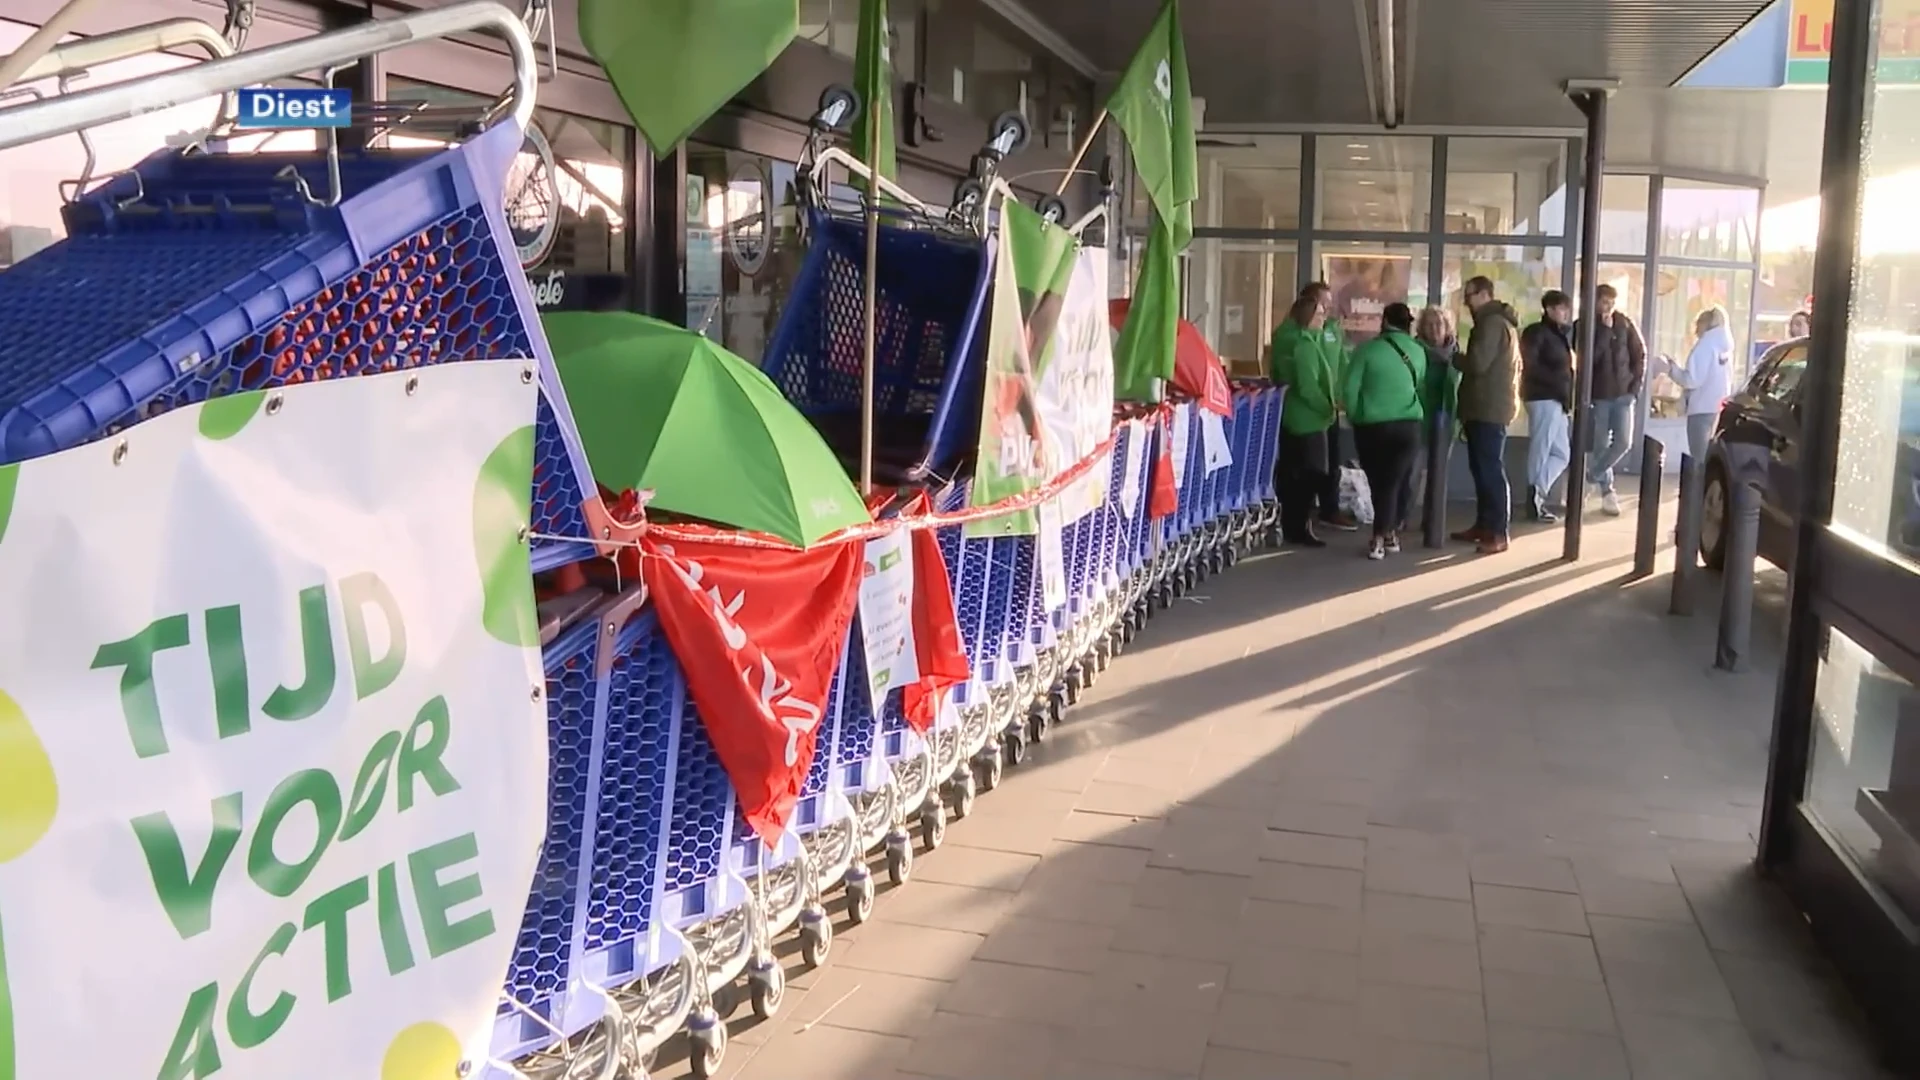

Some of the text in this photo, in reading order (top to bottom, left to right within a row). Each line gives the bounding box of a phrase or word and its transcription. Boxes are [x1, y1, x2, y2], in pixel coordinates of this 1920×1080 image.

[90, 572, 408, 759] TIJD
[130, 695, 461, 939] VOOR
[157, 832, 497, 1080] ACTIE
